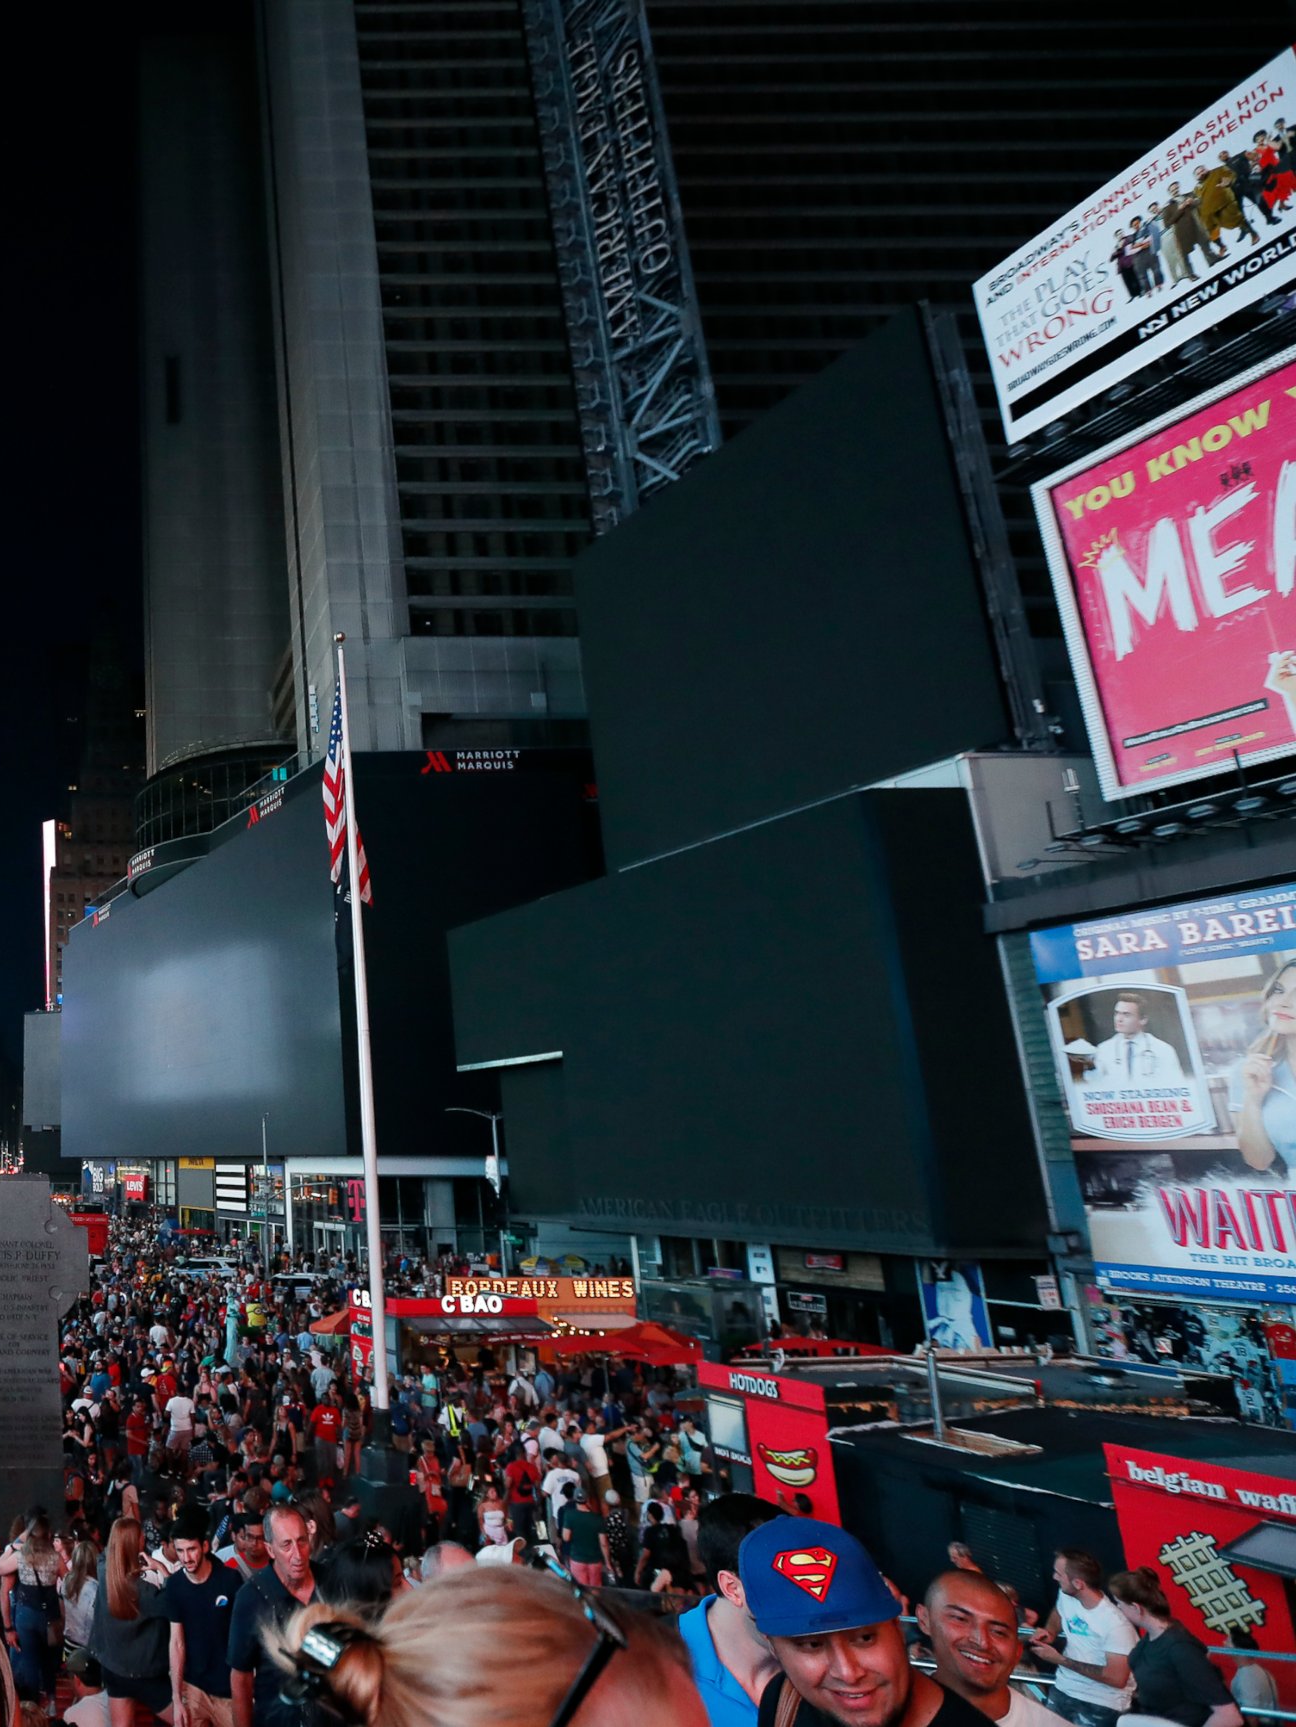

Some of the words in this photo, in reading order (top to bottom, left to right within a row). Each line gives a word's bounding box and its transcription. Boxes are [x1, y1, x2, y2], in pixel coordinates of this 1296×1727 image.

[989, 221, 1080, 289] BROADWAY'S
[1082, 160, 1159, 222] FUNNIEST
[1166, 110, 1230, 161] SMASH
[1237, 80, 1269, 110] HIT
[986, 281, 1015, 309] AND
[1017, 191, 1143, 285] INTERNATIONAL
[1148, 86, 1285, 190] PHENOMENON
[999, 298, 1032, 328] THE
[1034, 251, 1090, 303] PLAY
[995, 314, 1039, 348] THAT
[1040, 262, 1109, 317] GOES
[1176, 283, 1220, 322] NEW
[997, 289, 1115, 368] WRONG
[1063, 470, 1136, 521] YOU
[1146, 399, 1272, 483] KNOW
[457, 750, 521, 759] MARRIOTT
[457, 761, 514, 770] MARQUIS
[1073, 920, 1130, 938] ORIGINAL
[1131, 913, 1170, 929] MUSIC
[1173, 911, 1189, 921] BY
[1075, 928, 1168, 961] SARA
[1083, 1090, 1116, 1101] NOW
[1120, 1087, 1191, 1100] STARRING
[1085, 1101, 1145, 1115] SHOSHANA
[1147, 1100, 1178, 1113] BEAN
[1182, 1099, 1193, 1112] &
[1103, 1115, 1137, 1129] ERICH
[1138, 1114, 1183, 1129] BERGEN
[92, 1167, 104, 1182] BIG
[92, 1182, 104, 1193] BOLD
[577, 1198, 674, 1218] AMERICAN
[680, 1201, 748, 1223] EAGLE
[26, 1250, 61, 1260] DUFFY
[1189, 1253, 1220, 1265] THE
[1223, 1255, 1249, 1266] HIT
[451, 1280, 559, 1299] BORDEAUX
[573, 1280, 635, 1299] WINES
[1108, 1269, 1151, 1281] BROOKS
[1151, 1273, 1211, 1288] ATKINSON
[1213, 1278, 1267, 1292] THEATRE
[441, 1295, 456, 1313] C
[460, 1295, 503, 1314] BAO
[729, 1372, 779, 1399] HOTDOGS
[1125, 1460, 1228, 1501] belgian
